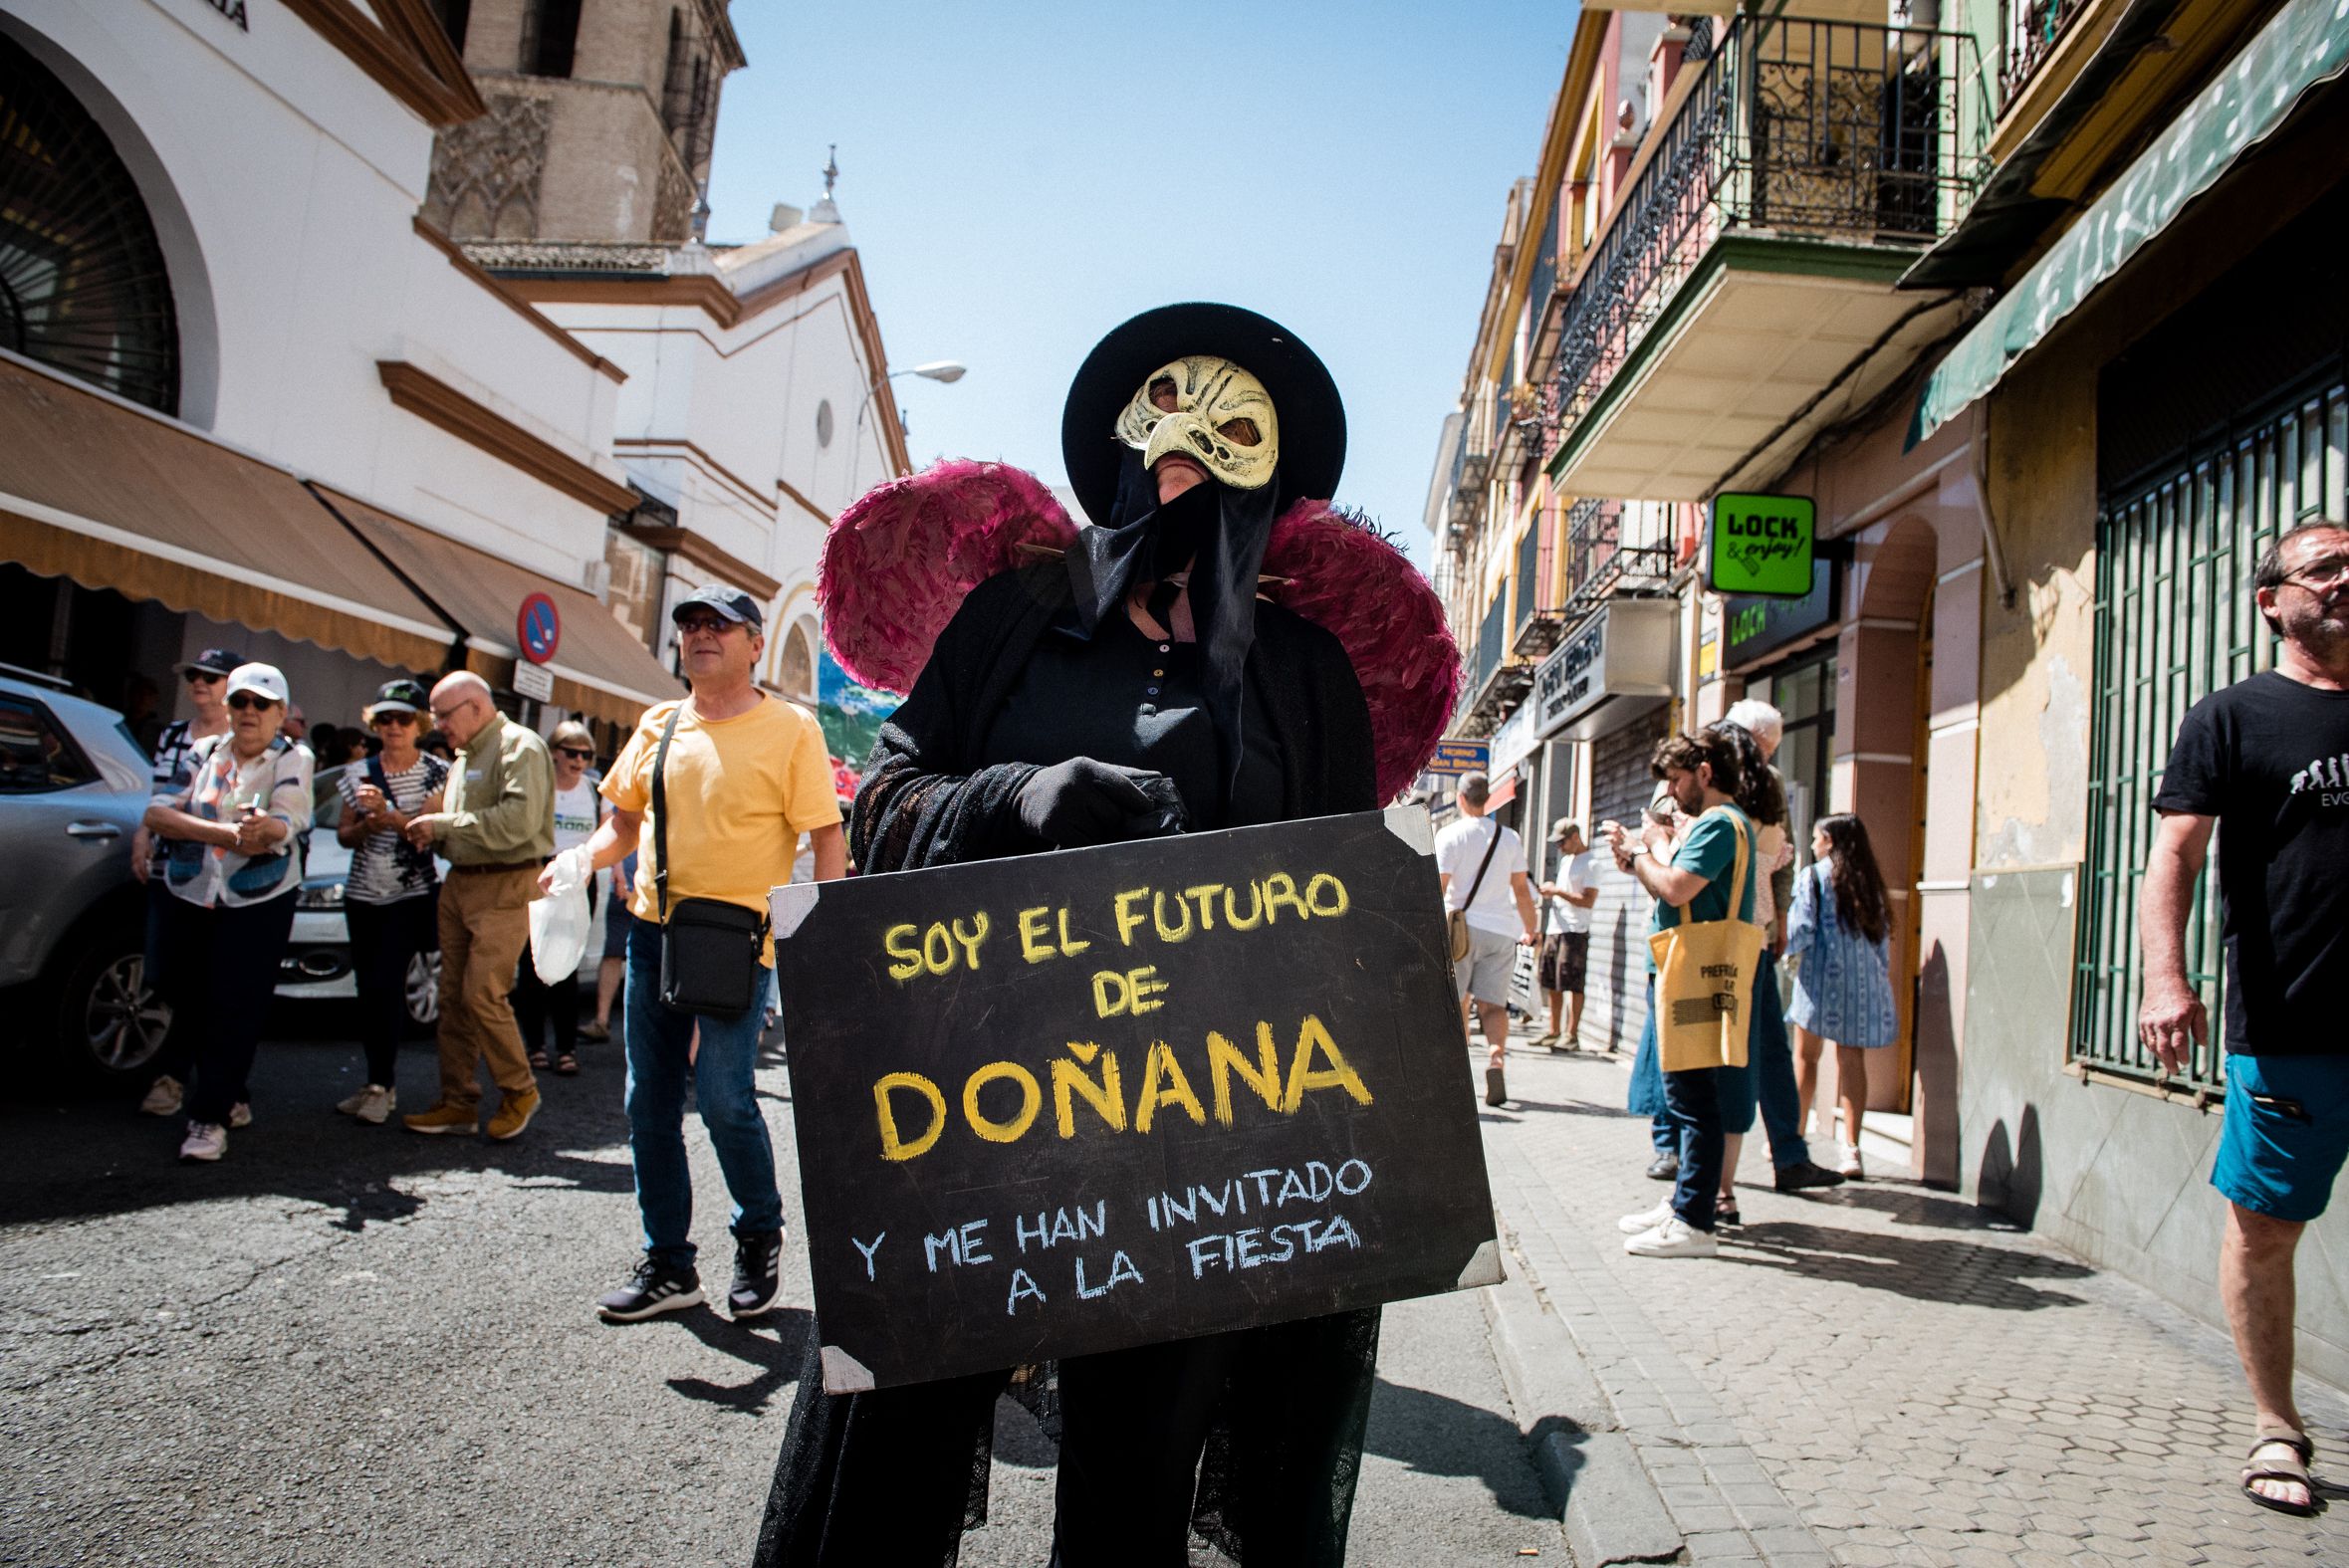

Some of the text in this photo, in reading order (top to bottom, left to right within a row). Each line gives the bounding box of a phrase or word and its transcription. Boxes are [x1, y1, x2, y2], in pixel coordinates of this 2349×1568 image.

[1728, 514, 1798, 539] LOCK
[1744, 536, 1805, 560] enjoy!
[1443, 748, 1478, 759] HORNO
[884, 872, 1349, 981] SOY EL FUTURO
[1093, 965, 1169, 1018] DE
[874, 1013, 1373, 1161] DOÑANA
[851, 1159, 1372, 1281] Y ME HAN INVITADO
[1007, 1214, 1360, 1315] A LA FIESTA
